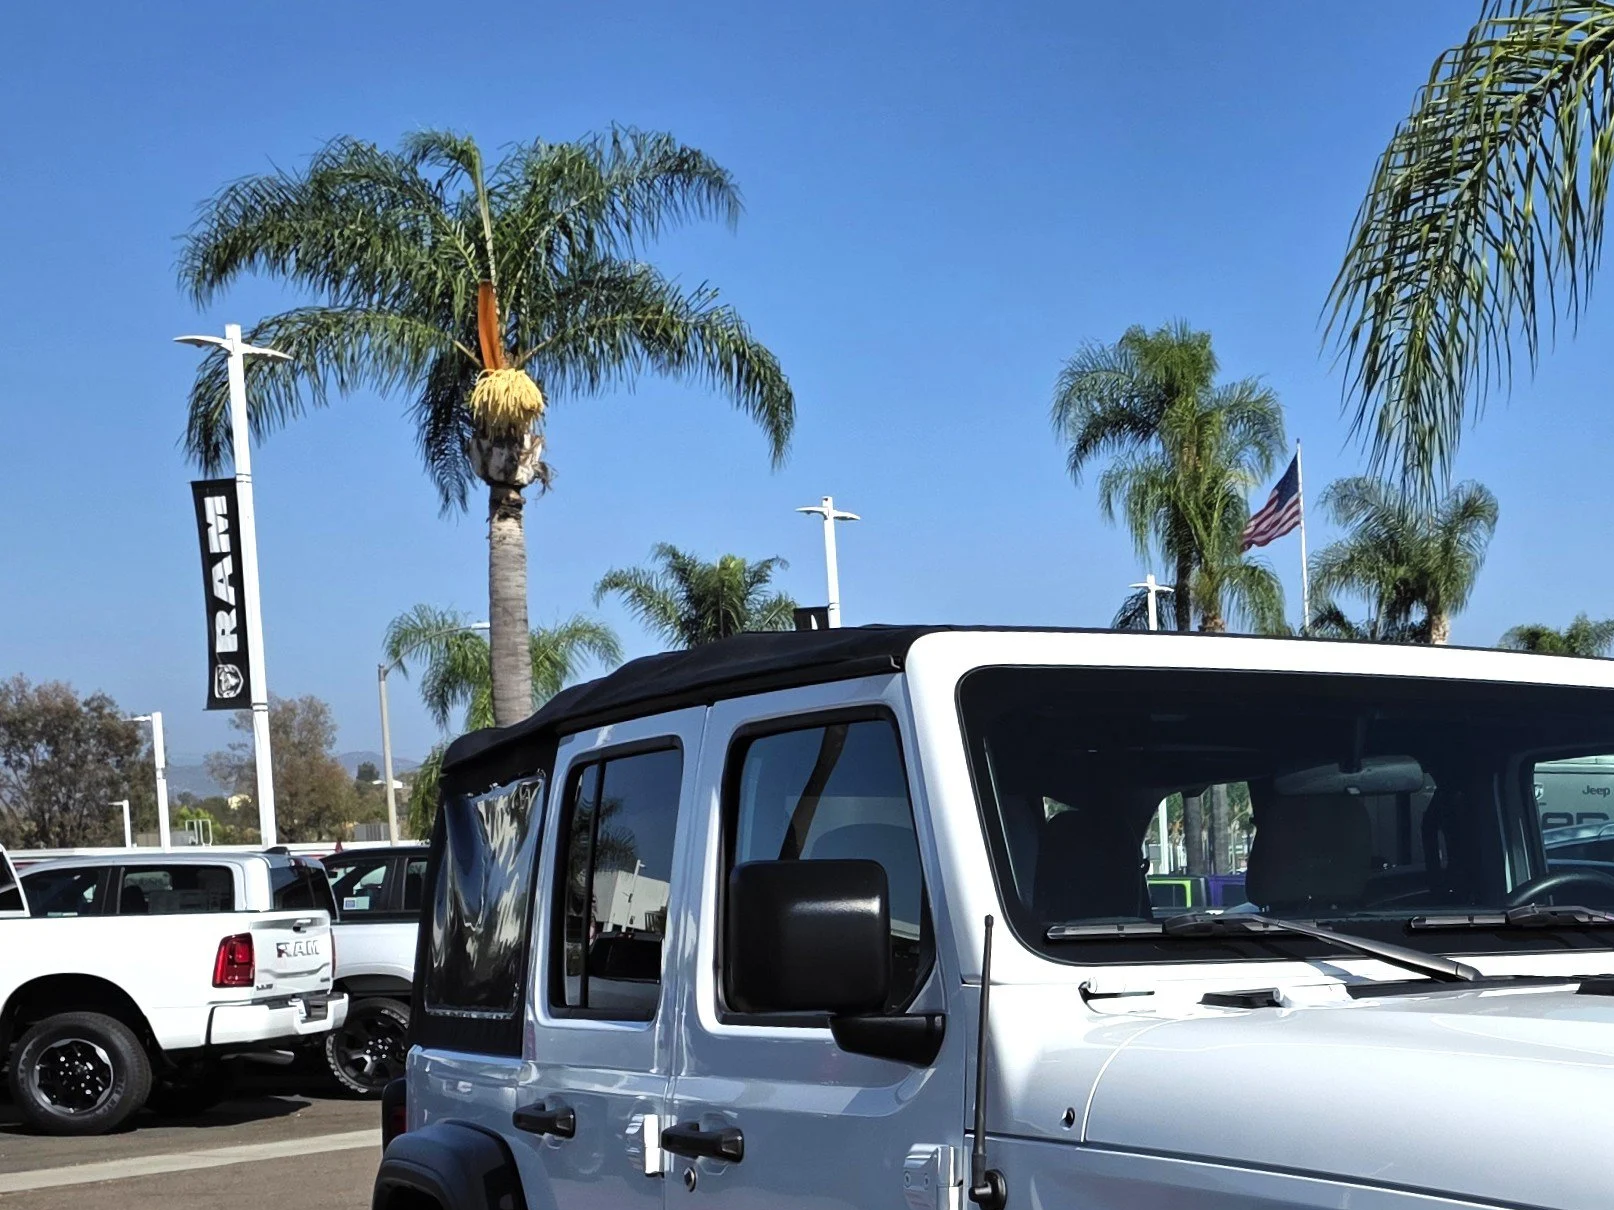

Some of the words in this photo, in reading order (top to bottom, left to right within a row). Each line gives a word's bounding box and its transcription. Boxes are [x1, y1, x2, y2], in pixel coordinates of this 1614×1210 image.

[204, 496, 238, 653] RAM
[1582, 785, 1611, 798] Jeep
[276, 939, 320, 958] RAM
